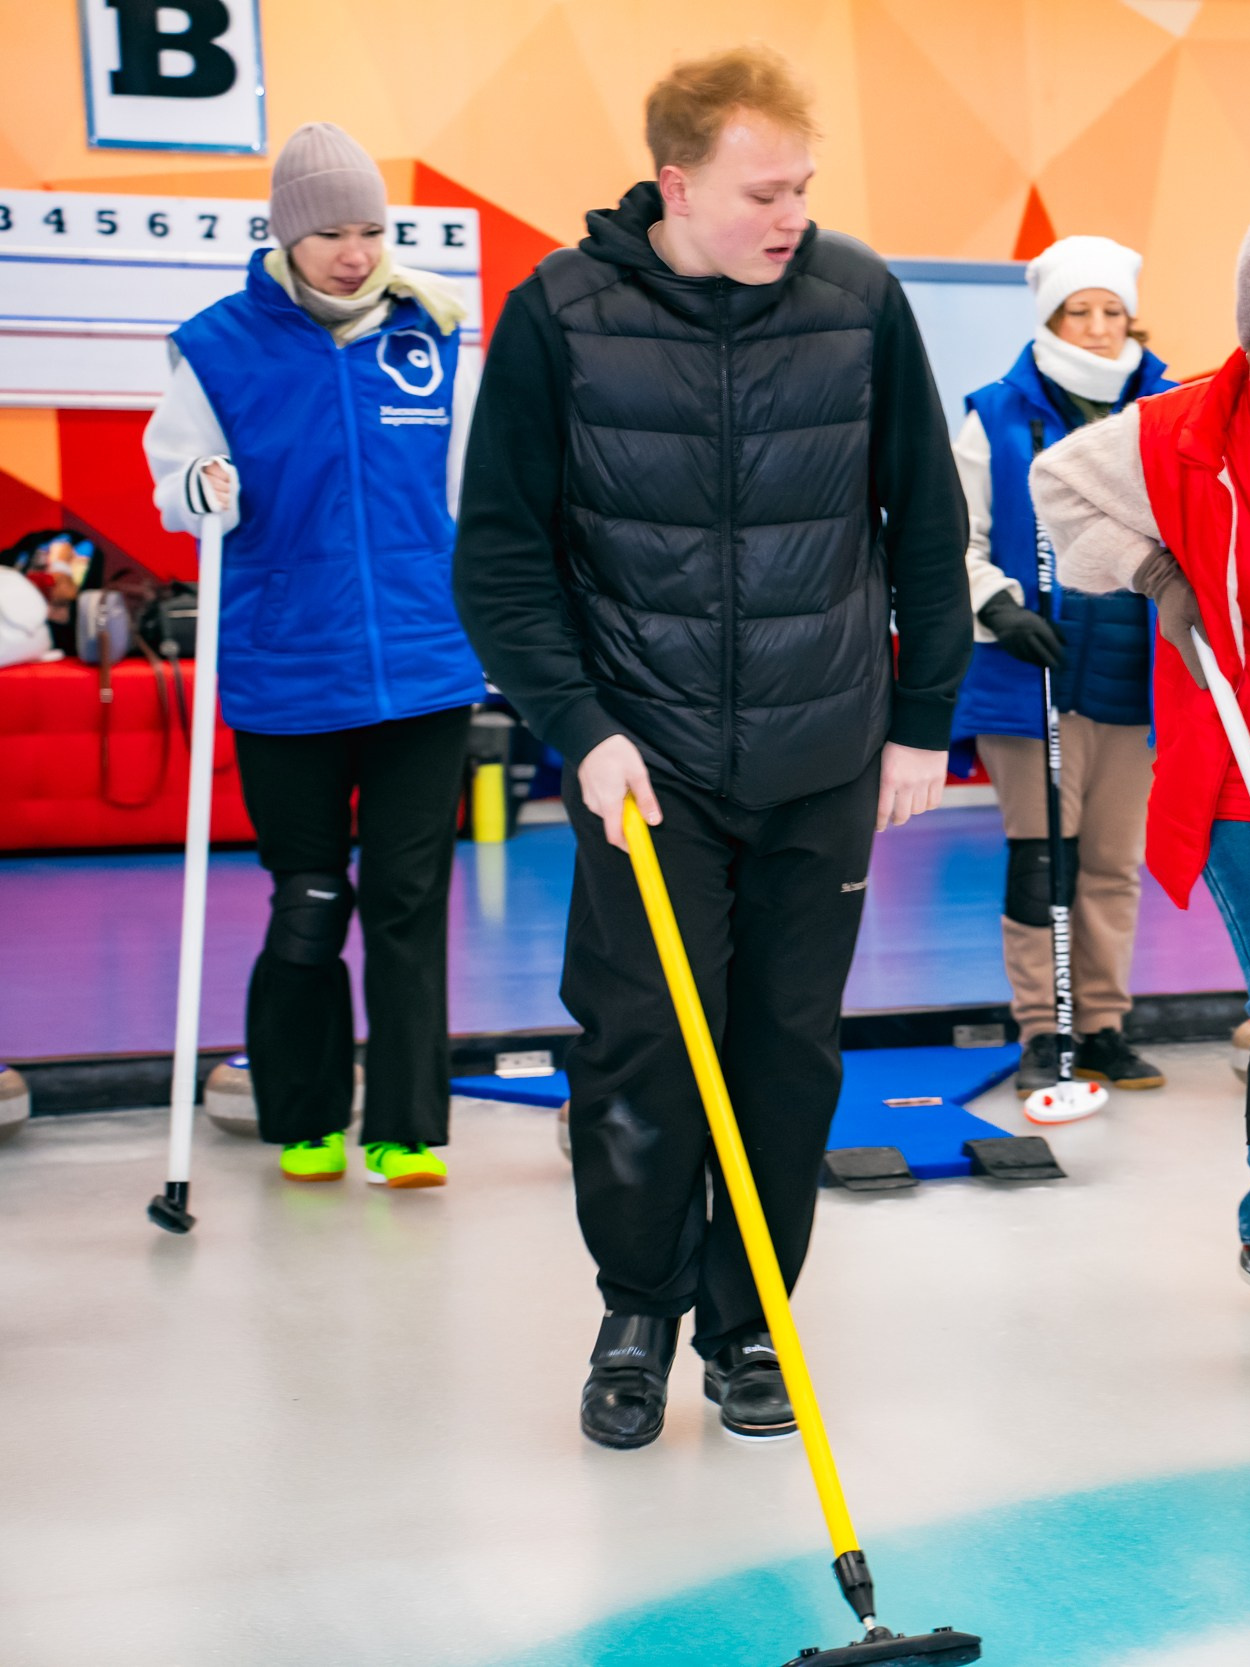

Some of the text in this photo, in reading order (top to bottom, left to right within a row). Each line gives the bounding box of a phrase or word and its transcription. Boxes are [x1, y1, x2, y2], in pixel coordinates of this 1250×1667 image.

[104, 0, 238, 98] B
[43, 207, 67, 234] 4
[97, 210, 118, 235] 5
[147, 212, 169, 237] 6
[197, 214, 218, 239] 7
[248, 216, 270, 241] 8
[395, 222, 417, 245] E
[443, 224, 465, 247] E
